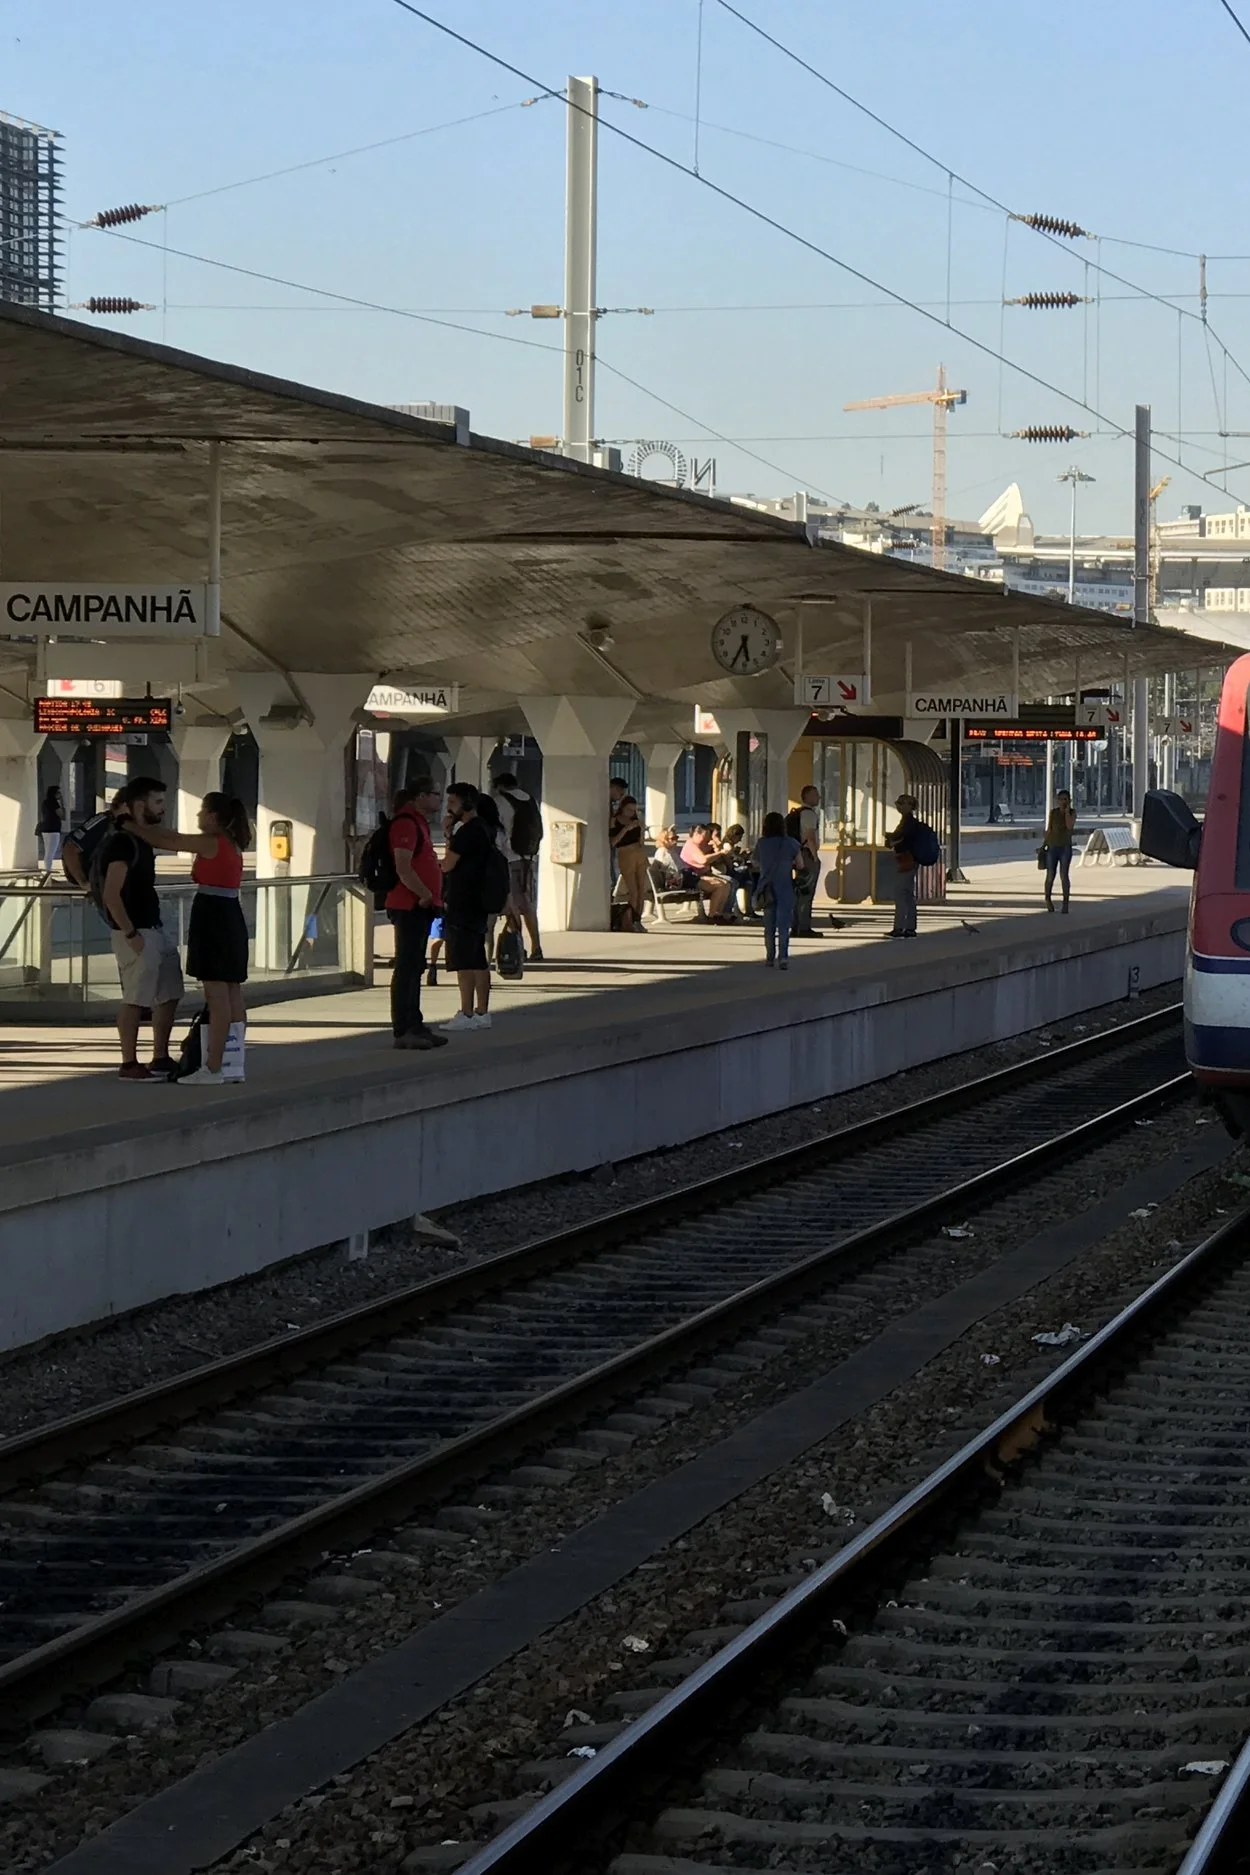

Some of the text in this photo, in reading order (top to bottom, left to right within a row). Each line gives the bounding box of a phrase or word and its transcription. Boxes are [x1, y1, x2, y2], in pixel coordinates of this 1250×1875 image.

[6, 589, 197, 623] CAMPANHÃ
[368, 690, 447, 707] AMPANHÃ
[811, 685, 823, 700] 7
[915, 696, 1008, 713] CAMPANHÃ
[1087, 711, 1096, 722] 7
[1163, 723, 1171, 733] 7
